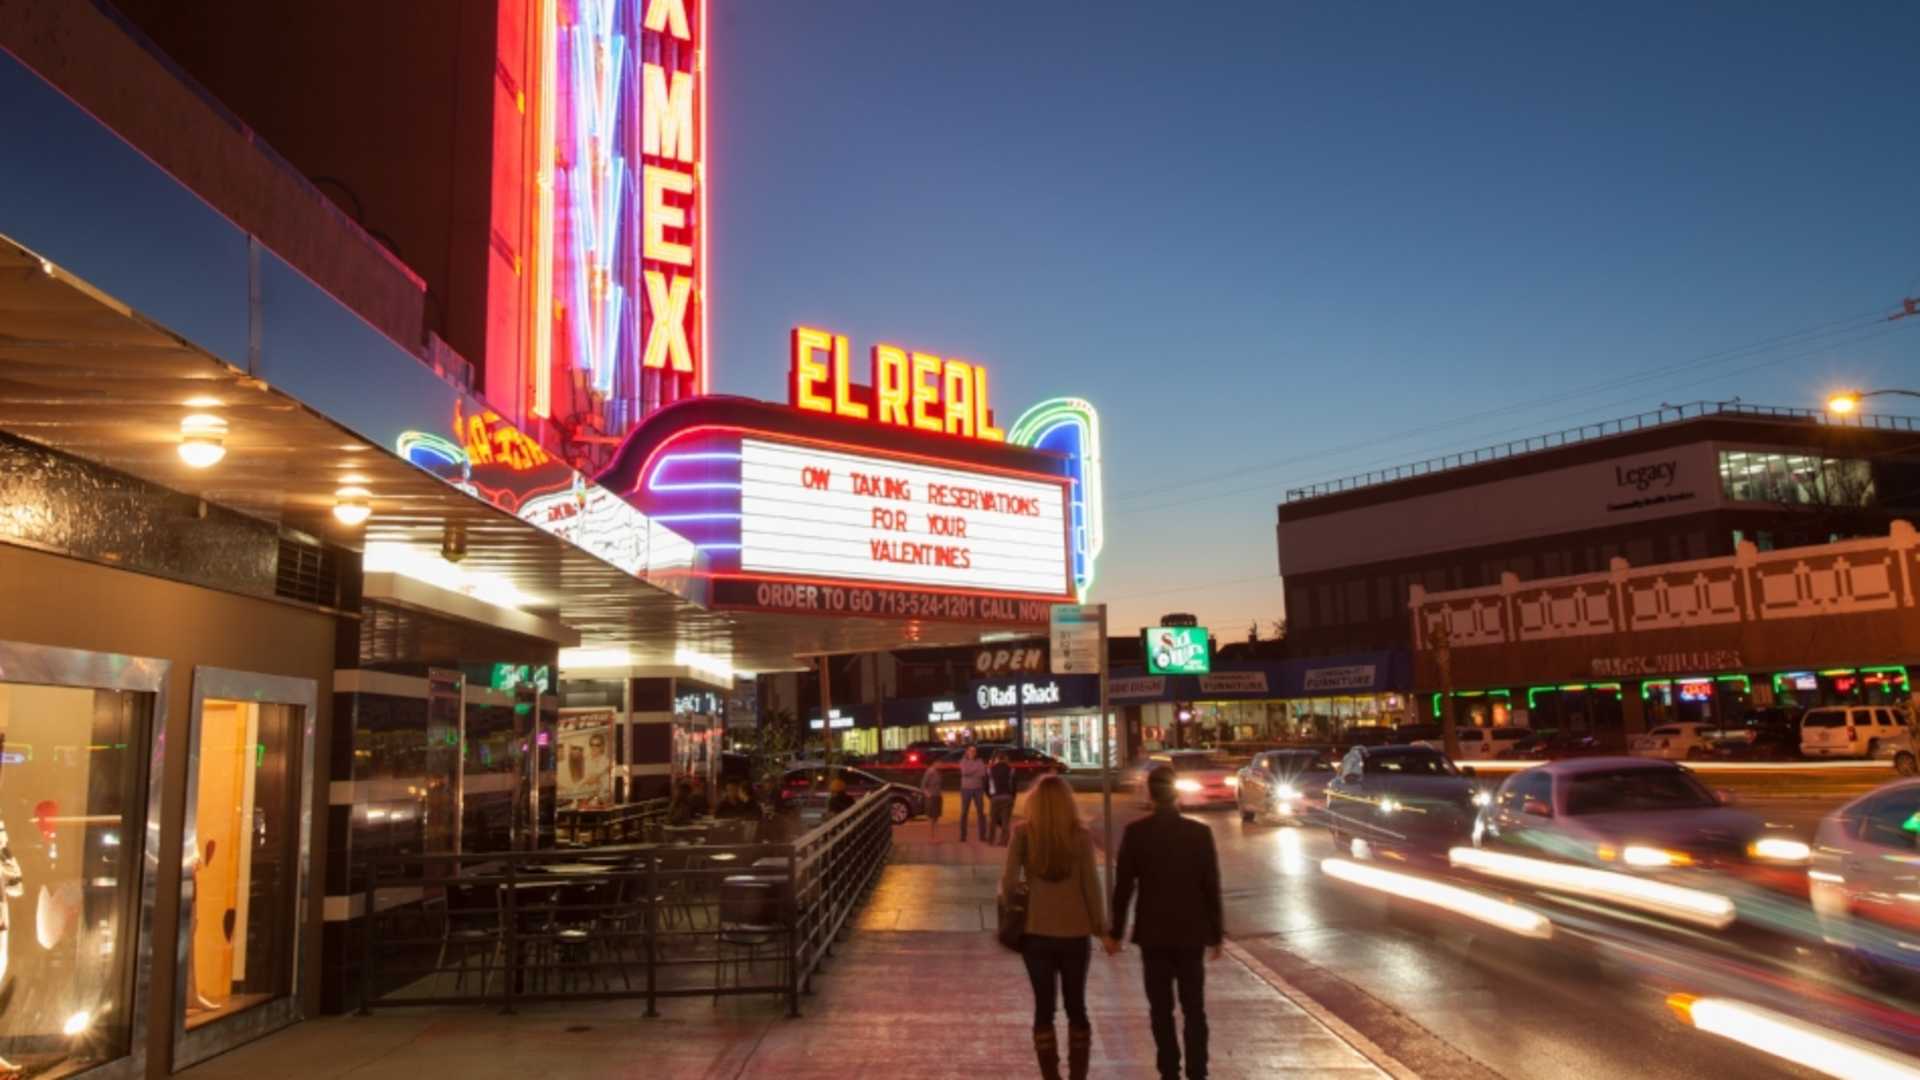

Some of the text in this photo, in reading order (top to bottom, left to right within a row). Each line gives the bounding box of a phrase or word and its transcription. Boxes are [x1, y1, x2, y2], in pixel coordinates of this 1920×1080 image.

[642, 62, 693, 374] MEX
[793, 325, 1005, 443] EL REAL
[1615, 460, 1677, 491] Legacy
[850, 472, 912, 501] TAKING
[927, 483, 1041, 517] RESERVATIONS
[871, 507, 967, 538] FOR YOUR
[869, 539, 971, 569] VALENTINES
[757, 583, 818, 610] ORDER
[822, 588, 845, 609] TO
[850, 591, 873, 612] GO
[877, 591, 976, 617] 713-524-1201
[979, 600, 1016, 620] CALL
[977, 648, 1041, 671] OPEN
